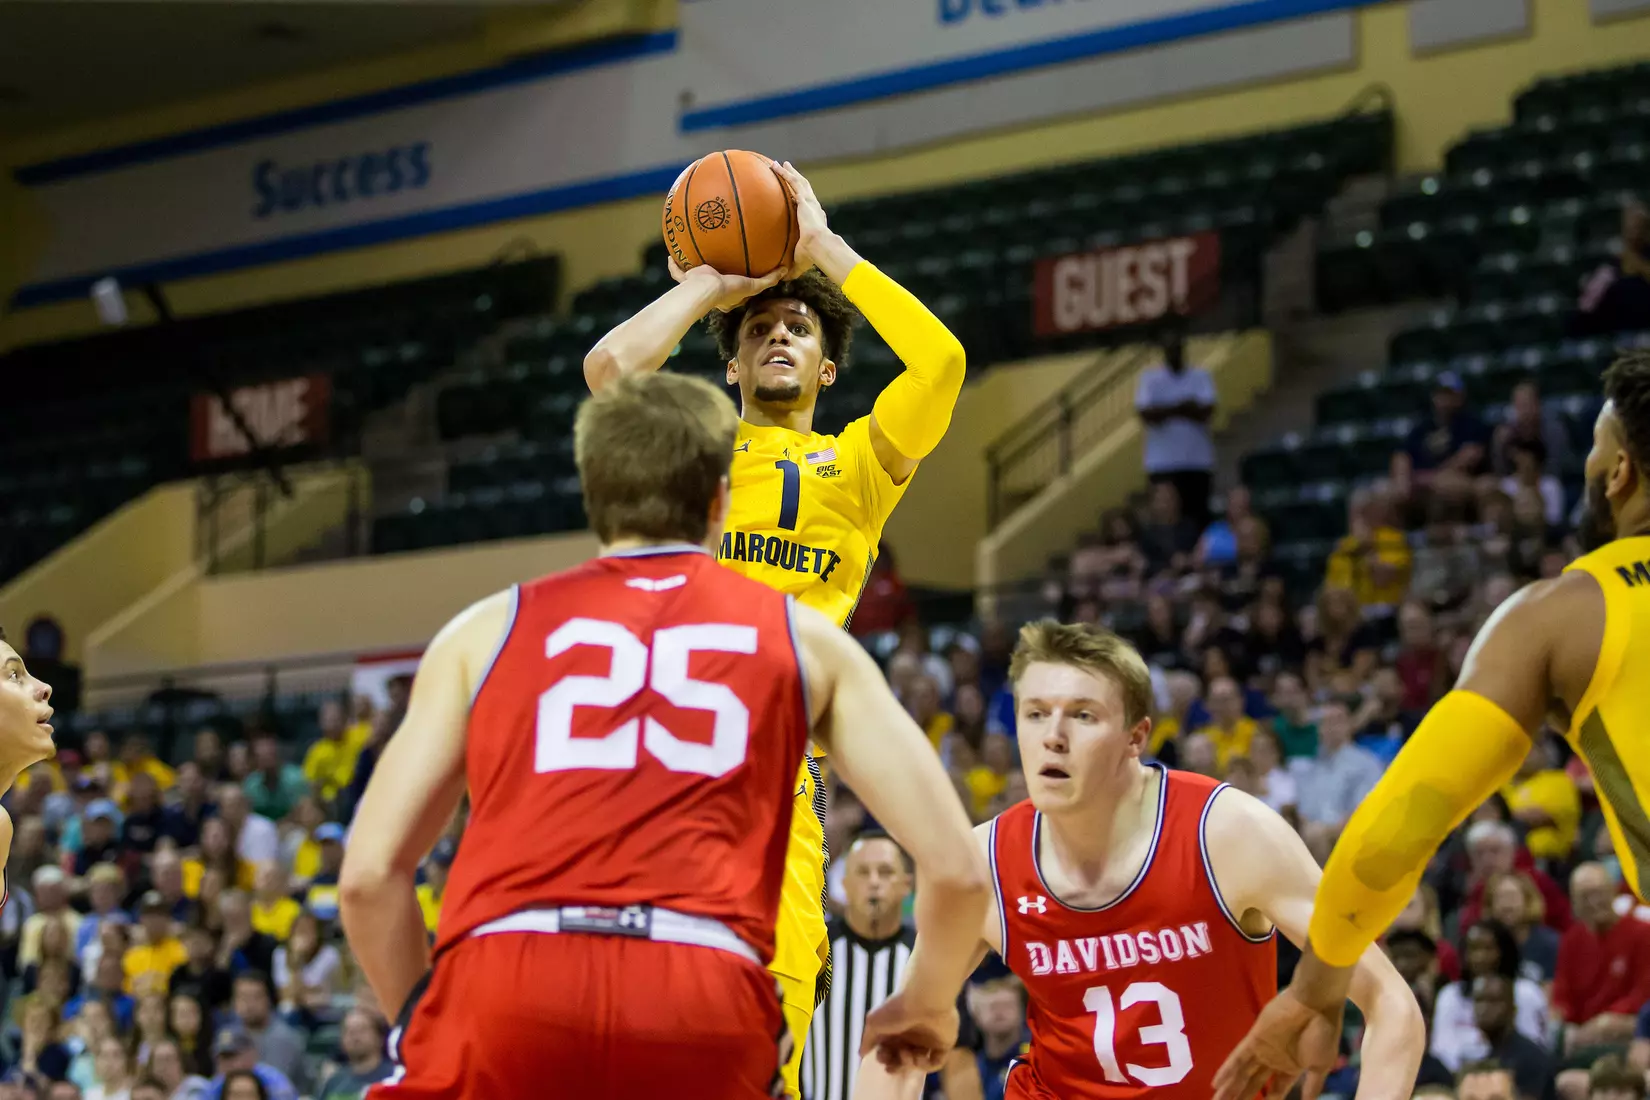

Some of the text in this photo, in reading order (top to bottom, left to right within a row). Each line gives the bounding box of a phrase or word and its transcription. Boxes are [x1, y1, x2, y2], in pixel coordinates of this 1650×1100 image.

[254, 143, 430, 219] Success
[715, 196, 732, 230] ORLANDO
[1053, 237, 1197, 332] GUEST
[775, 460, 800, 531] 1
[535, 617, 758, 779] 25
[1025, 921, 1213, 976] DAVIDSON
[1082, 981, 1193, 1087] 13
